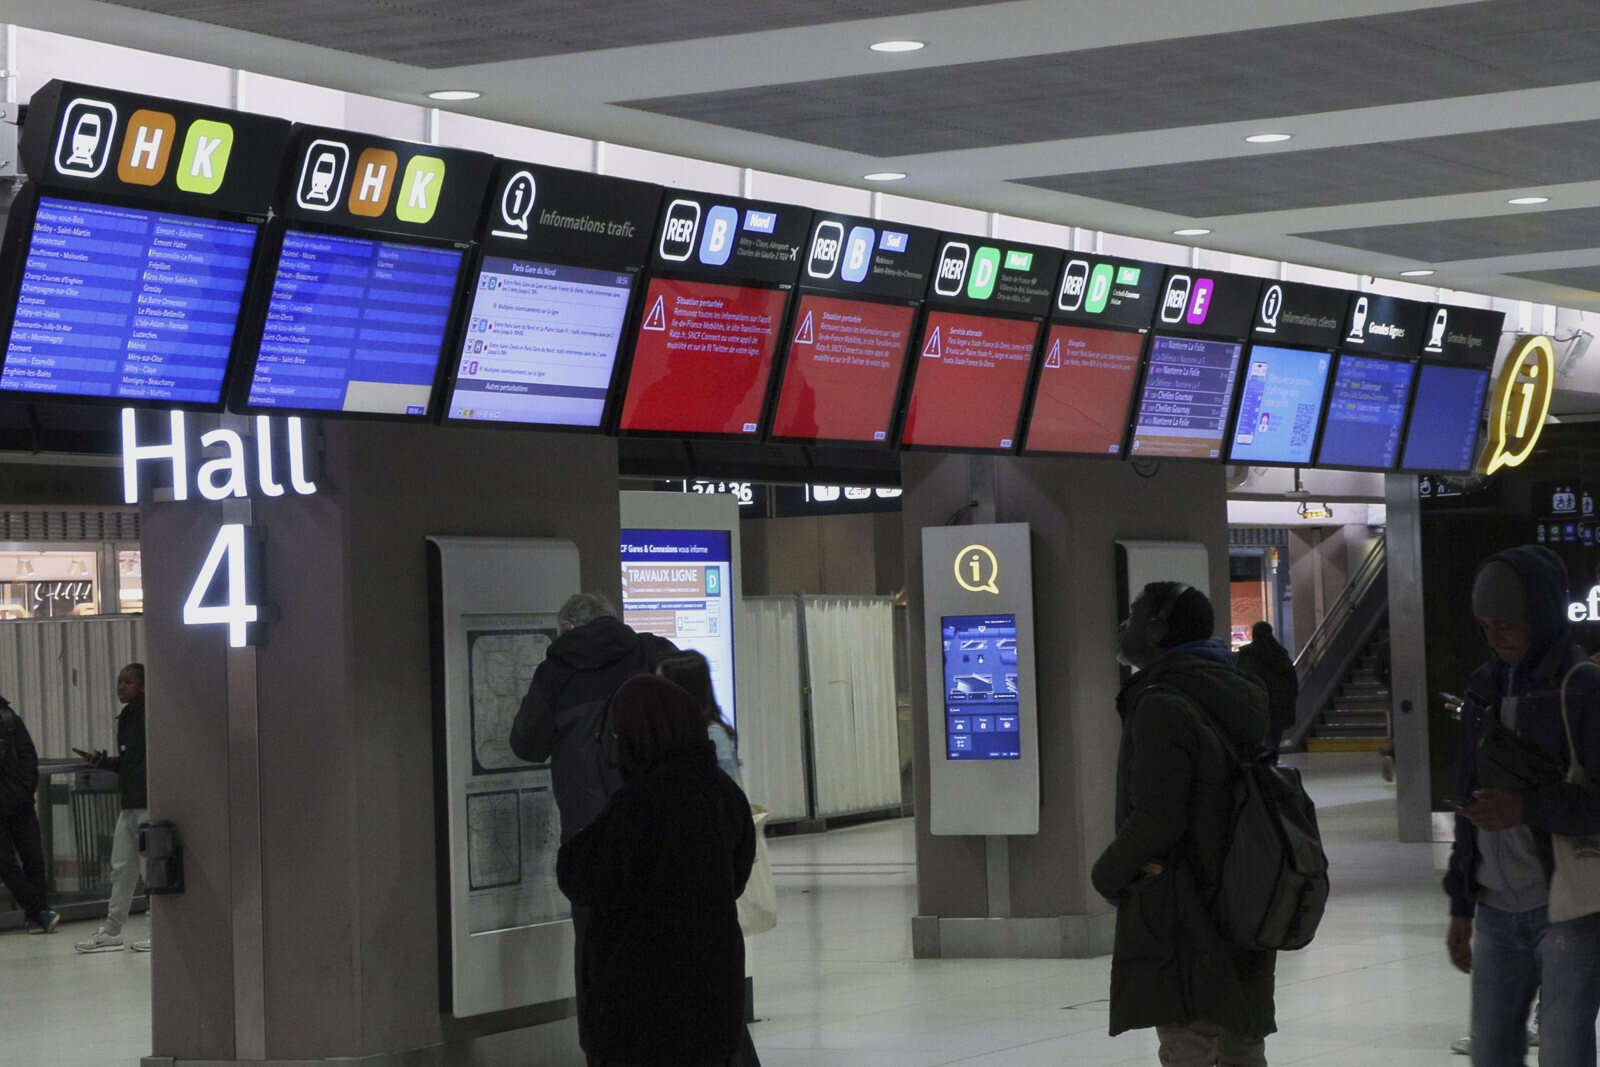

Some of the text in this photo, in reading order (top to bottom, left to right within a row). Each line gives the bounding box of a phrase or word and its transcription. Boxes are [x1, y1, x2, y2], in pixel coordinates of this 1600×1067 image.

[130, 126, 222, 178] H K
[359, 163, 436, 209] H K
[540, 208, 636, 238] Informations trafic
[666, 218, 728, 252] RER B
[750, 214, 771, 229] Nord
[511, 263, 524, 272] Paris
[814, 238, 866, 270] RER B
[941, 258, 992, 288] RER D
[1064, 275, 1106, 302] RER D
[1166, 288, 1208, 314] RER E
[122, 408, 317, 503] Hall
[729, 482, 752, 501] 36
[184, 524, 258, 647] 4
[628, 570, 669, 582] TRAVAUX
[671, 570, 698, 582] LIGNE
